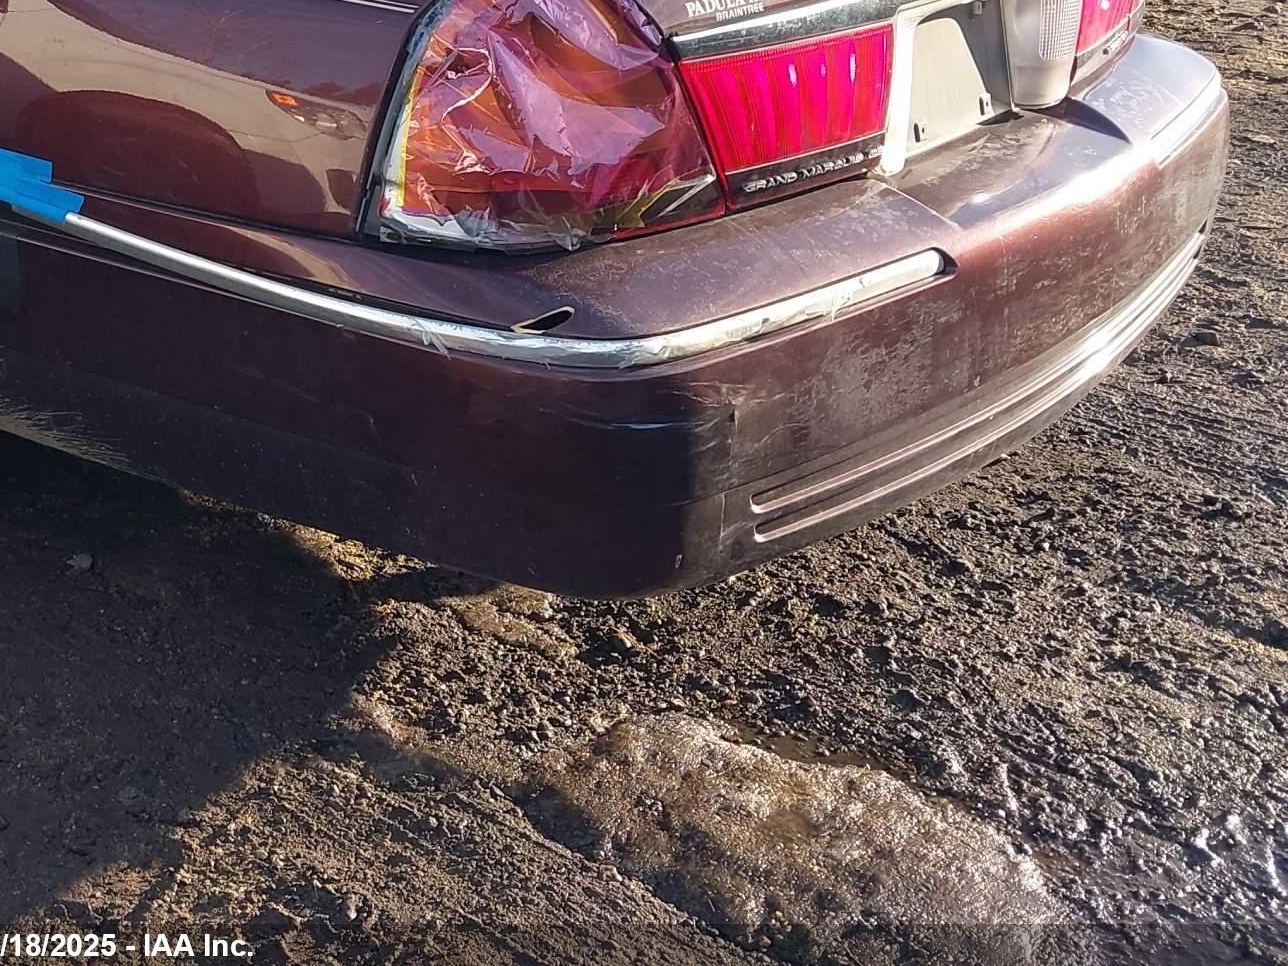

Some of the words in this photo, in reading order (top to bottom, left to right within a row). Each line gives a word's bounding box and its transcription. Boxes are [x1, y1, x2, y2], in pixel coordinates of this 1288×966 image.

[716, 1, 765, 22] BRAINTREE
[744, 171, 799, 193] GRAND
[800, 152, 865, 180] MARQUIS
